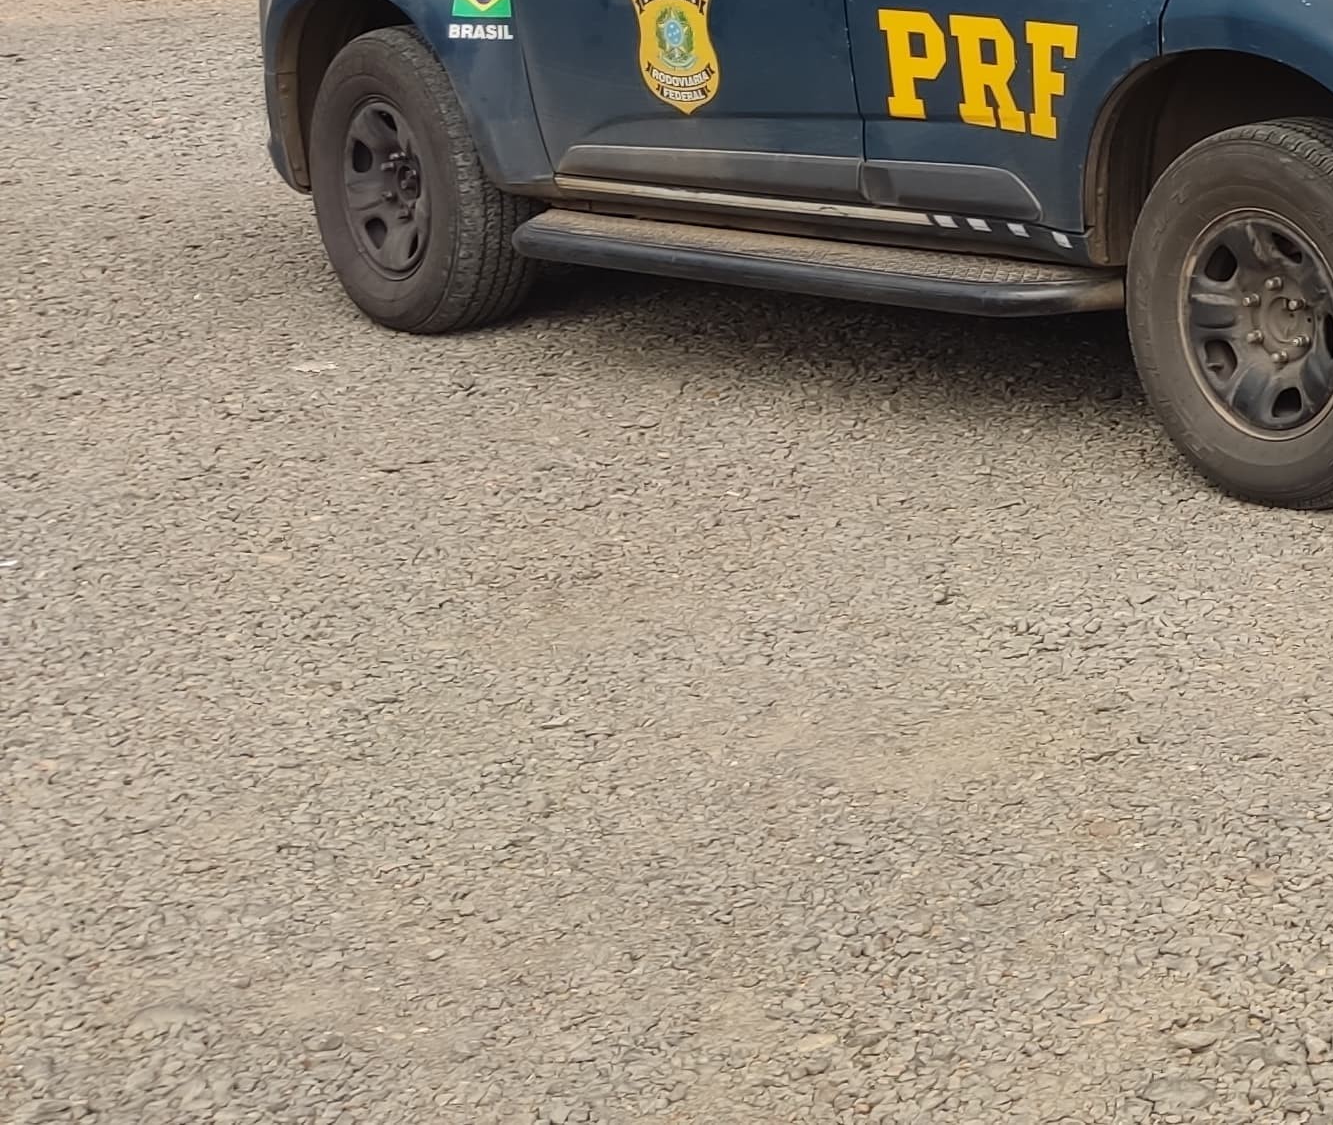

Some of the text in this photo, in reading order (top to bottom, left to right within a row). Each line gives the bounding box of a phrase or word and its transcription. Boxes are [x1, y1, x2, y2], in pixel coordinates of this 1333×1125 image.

[448, 24, 514, 40] BRASIL
[877, 8, 1079, 140] PRF
[663, 89, 706, 101] FEDERAL
